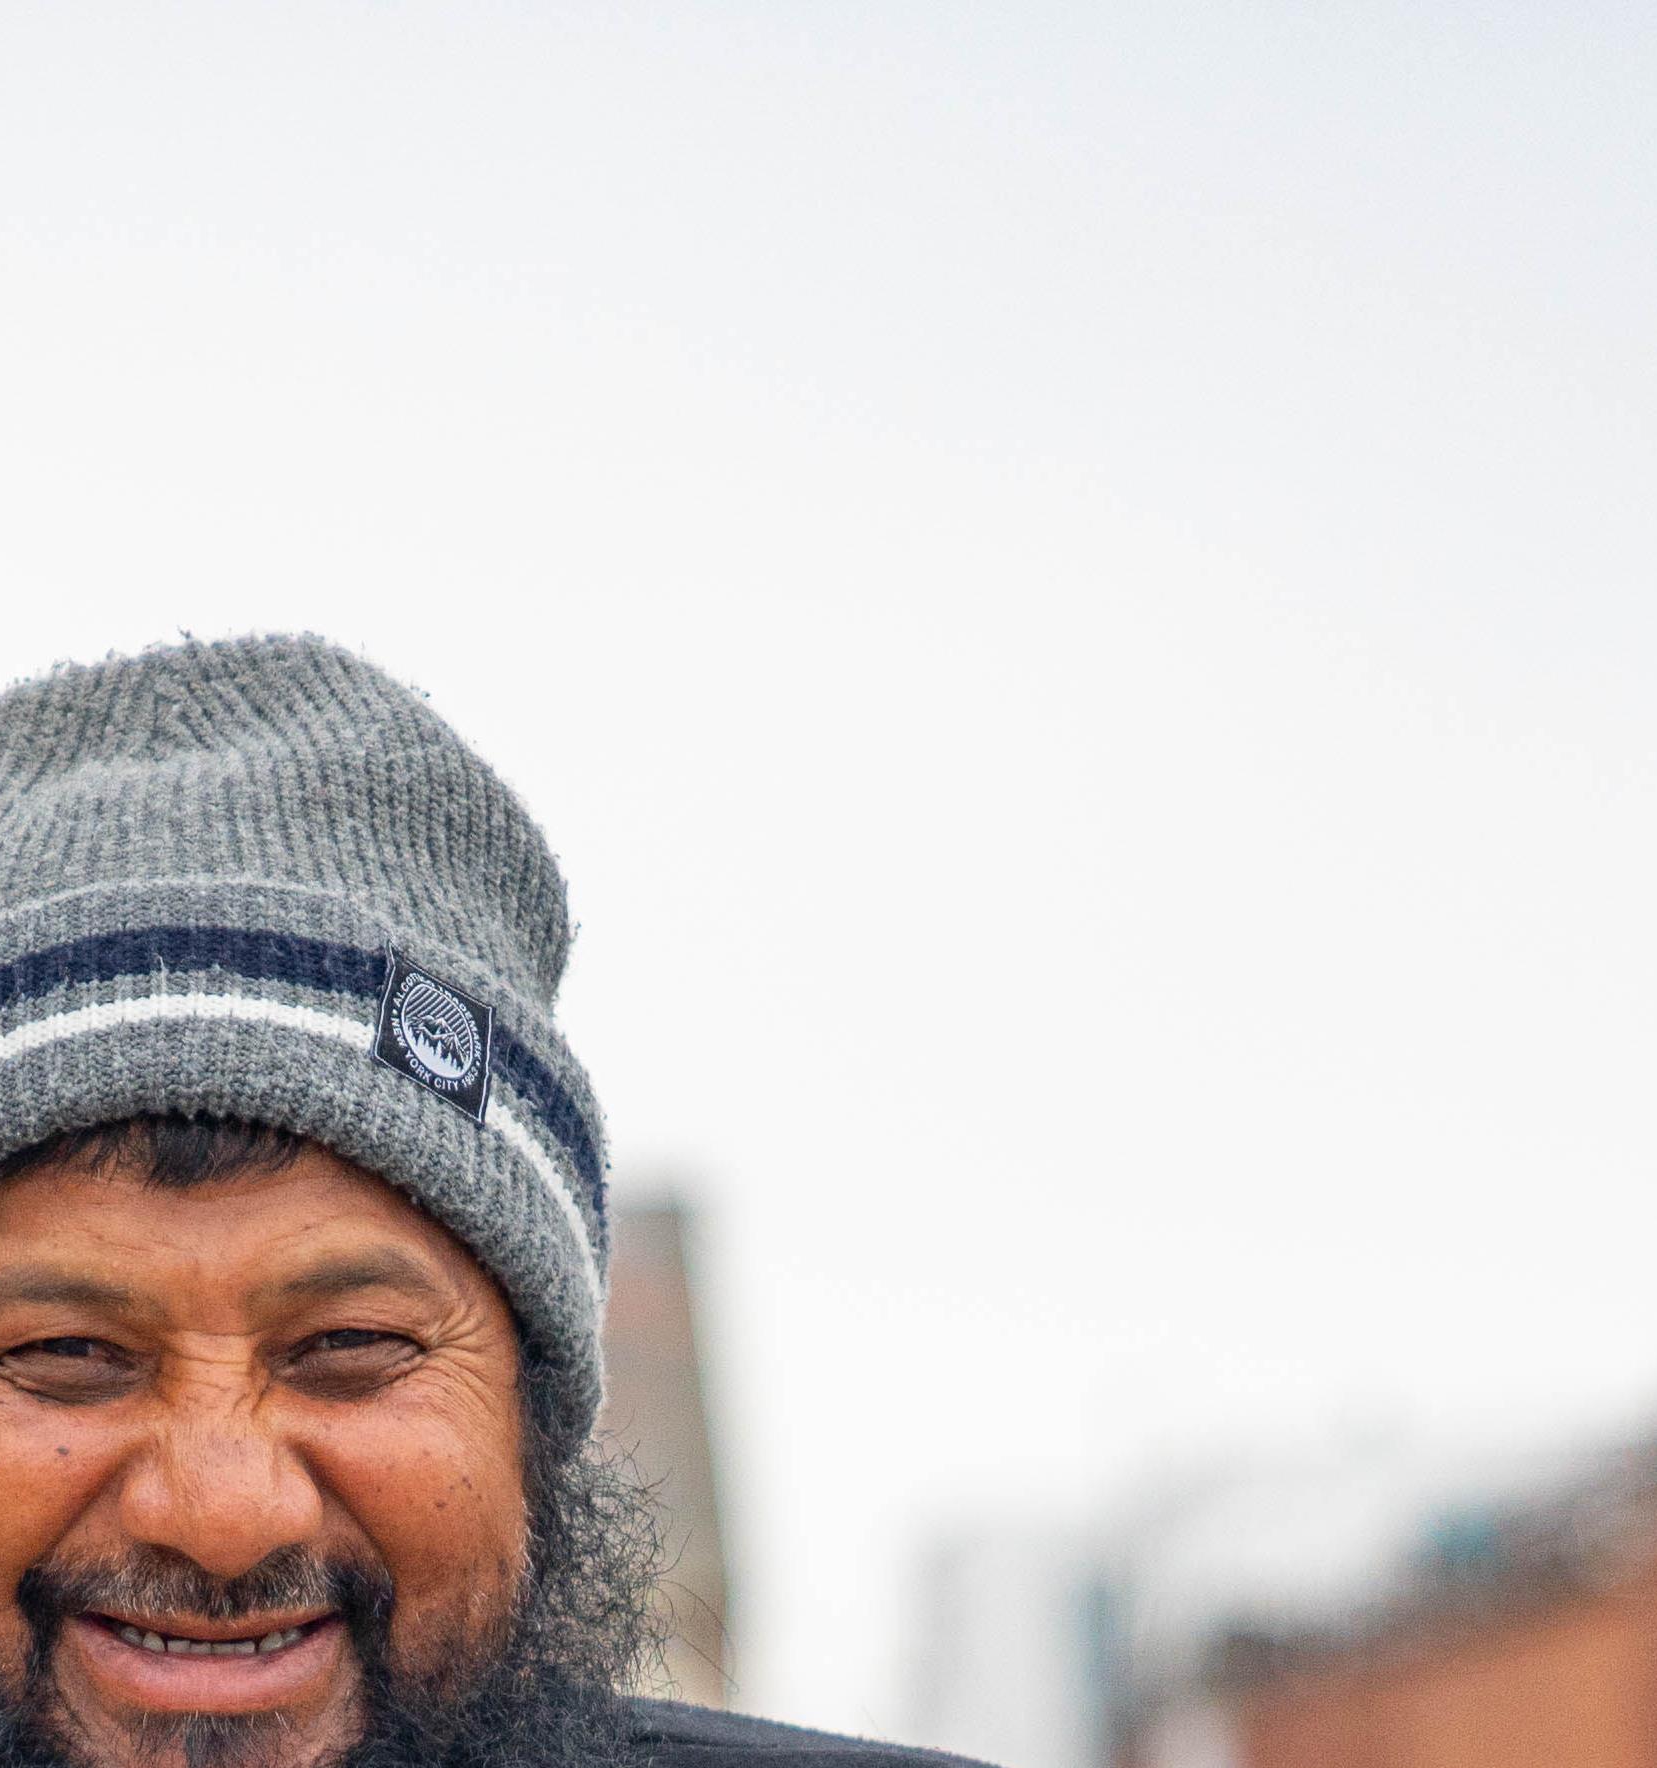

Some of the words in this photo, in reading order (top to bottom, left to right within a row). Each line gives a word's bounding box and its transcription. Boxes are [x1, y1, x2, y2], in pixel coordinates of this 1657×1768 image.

[390, 1017, 408, 1049] NEW
[405, 1049, 433, 1084] YORK
[434, 1077, 459, 1092] CITY
